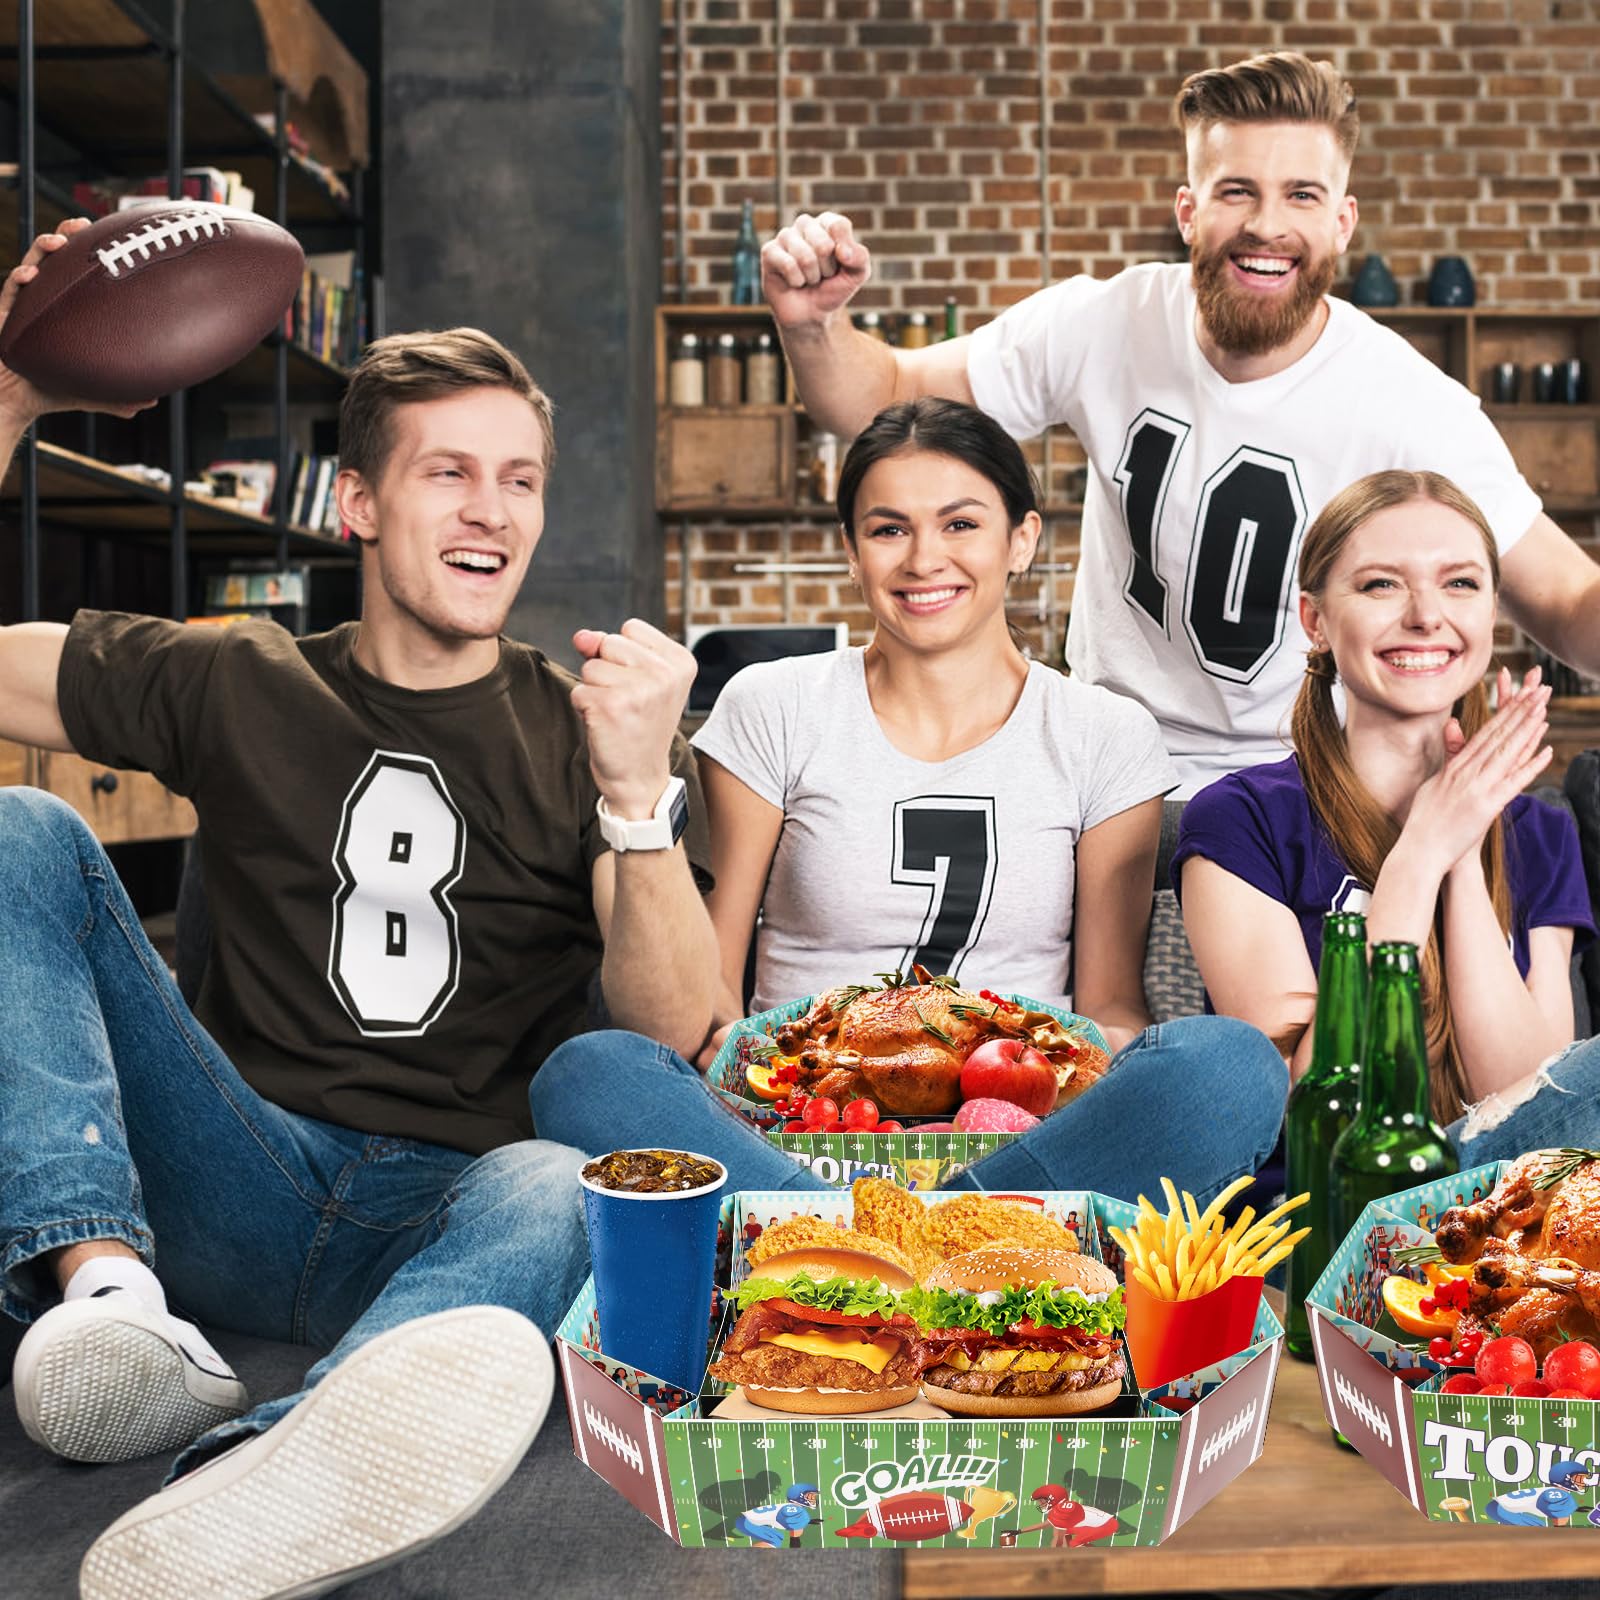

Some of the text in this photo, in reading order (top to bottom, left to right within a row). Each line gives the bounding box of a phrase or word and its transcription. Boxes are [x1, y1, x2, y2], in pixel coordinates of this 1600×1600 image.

[1113, 406, 1308, 686] 10
[327, 748, 467, 1038] 8
[890, 793, 998, 987] 7
[707, 1437, 722, 1449] 10
[756, 1437, 775, 1449] 20
[807, 1438, 827, 1449] 30
[860, 1438, 878, 1449] 40
[911, 1438, 931, 1449] 50
[963, 1438, 982, 1449] 40
[1015, 1437, 1034, 1449] 30
[1066, 1437, 1086, 1449] 20
[1455, 1411, 1577, 1428] 10 20 30
[1548, 1491, 1562, 1499] 23
